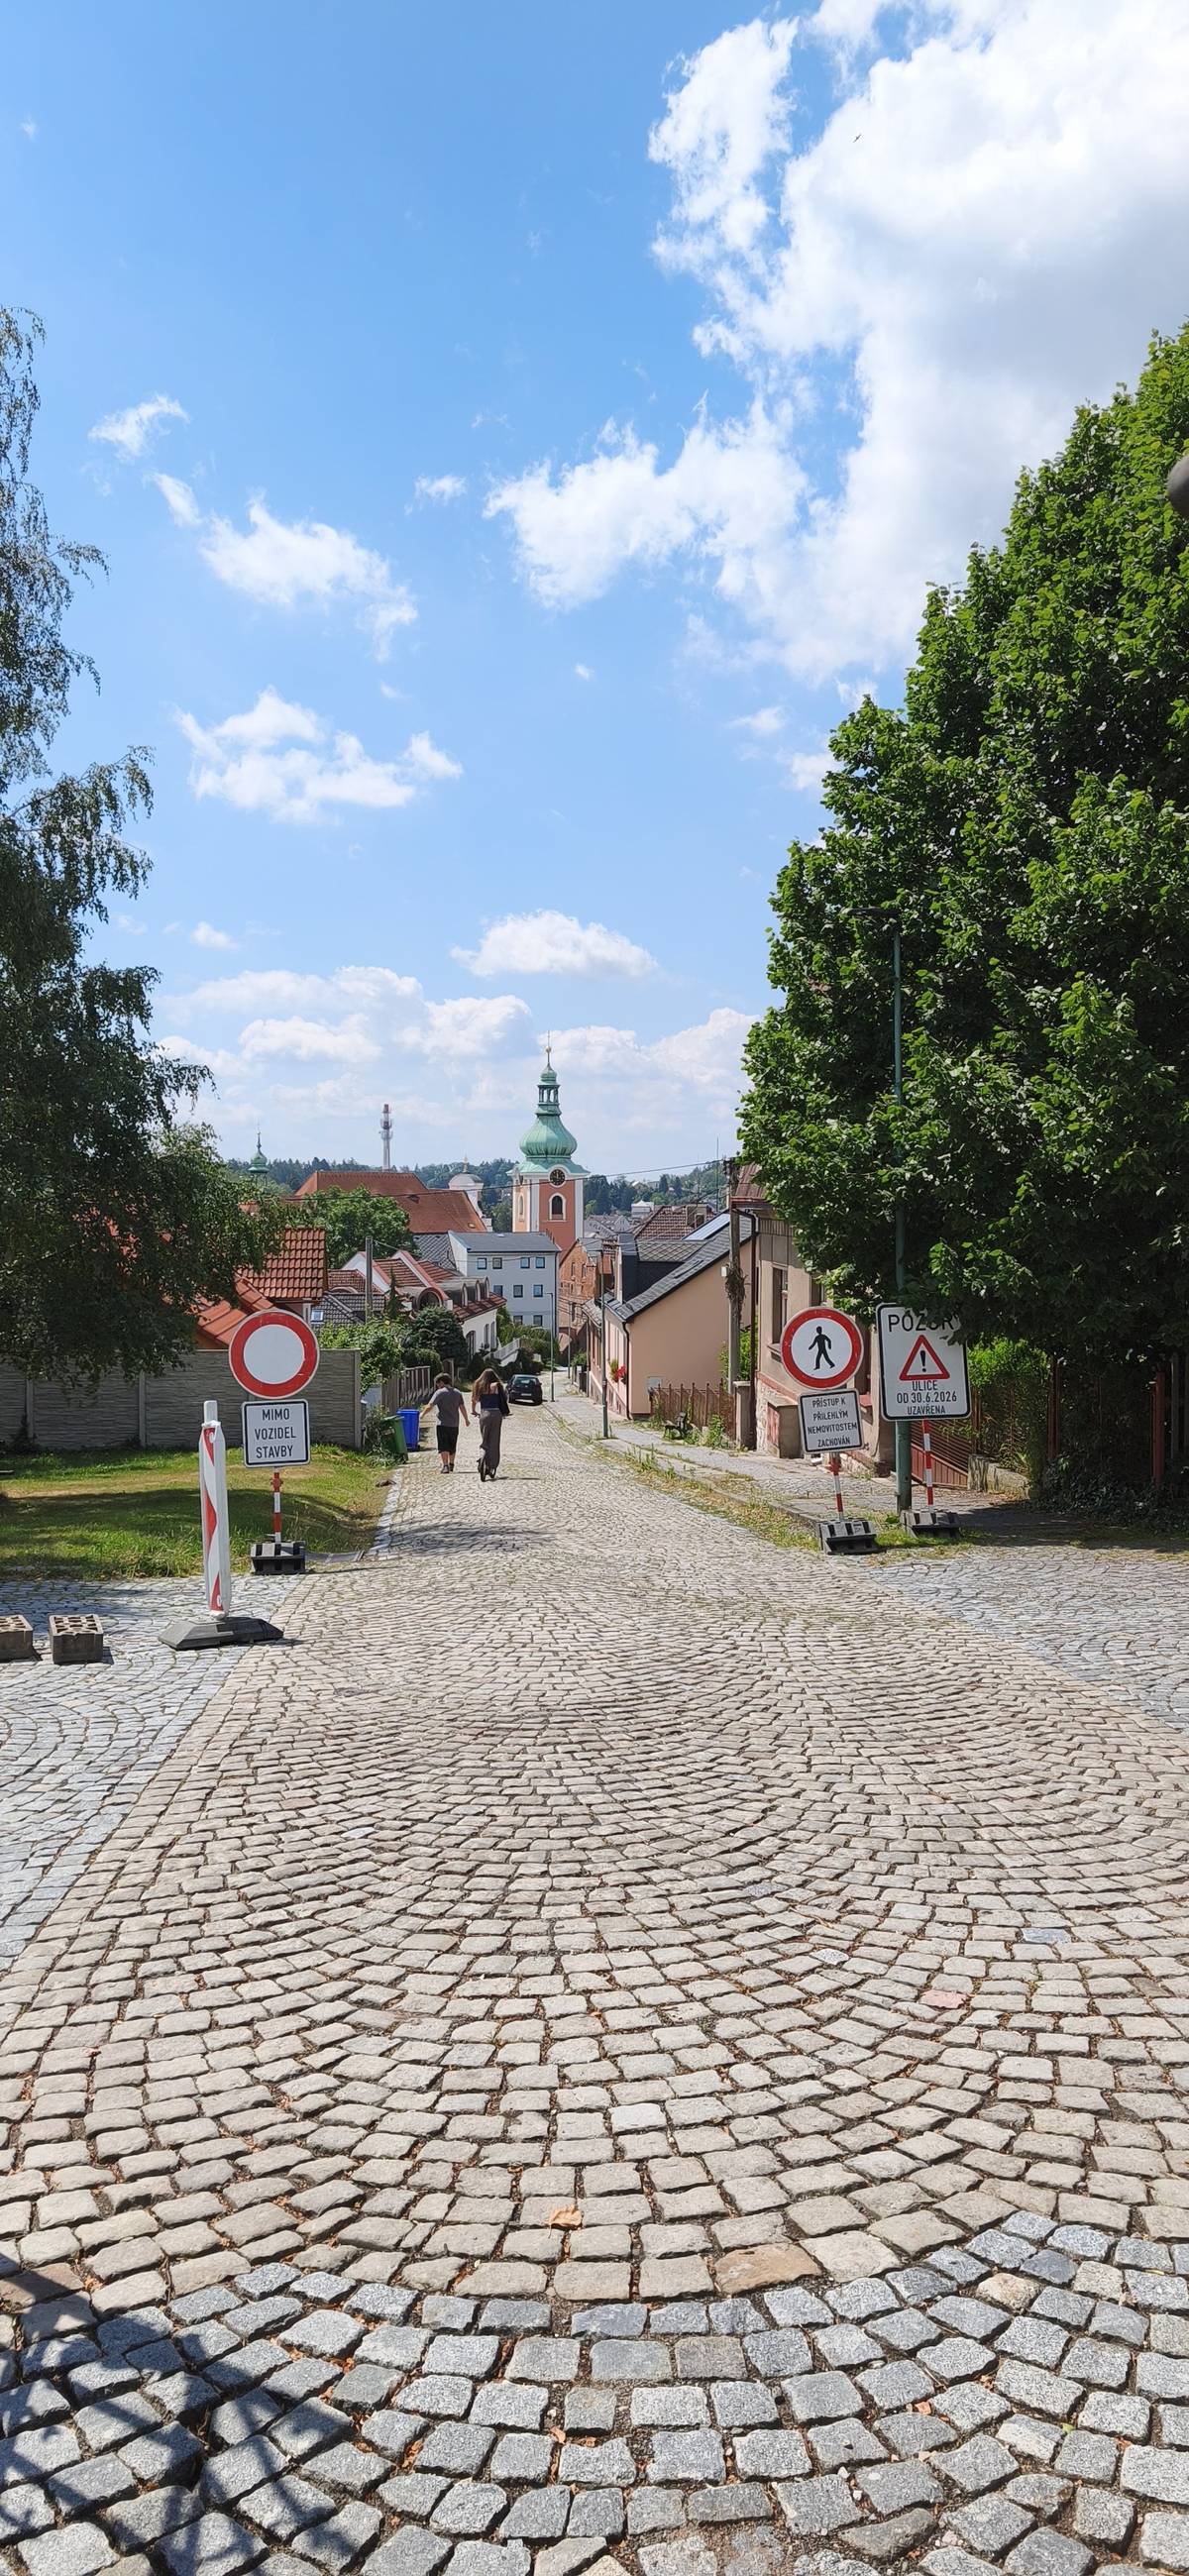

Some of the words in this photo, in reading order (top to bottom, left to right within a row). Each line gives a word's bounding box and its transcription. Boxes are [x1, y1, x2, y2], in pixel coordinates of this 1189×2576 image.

[912, 1380, 938, 1391] ULICE
[812, 1398, 839, 1408] PŘÍSTUP
[841, 1397, 846, 1406] K
[897, 1392, 909, 1404] OD
[912, 1390, 957, 1403] 30.6.2026
[262, 1408, 290, 1421] MIMO
[907, 1404, 946, 1415] UZAVŘENA
[254, 1427, 297, 1441] VOZIDEL
[808, 1422, 858, 1435] NEMOVITOSTEM
[817, 1436, 851, 1448] ZACHOVÁN
[256, 1445, 293, 1459] STAVBY
